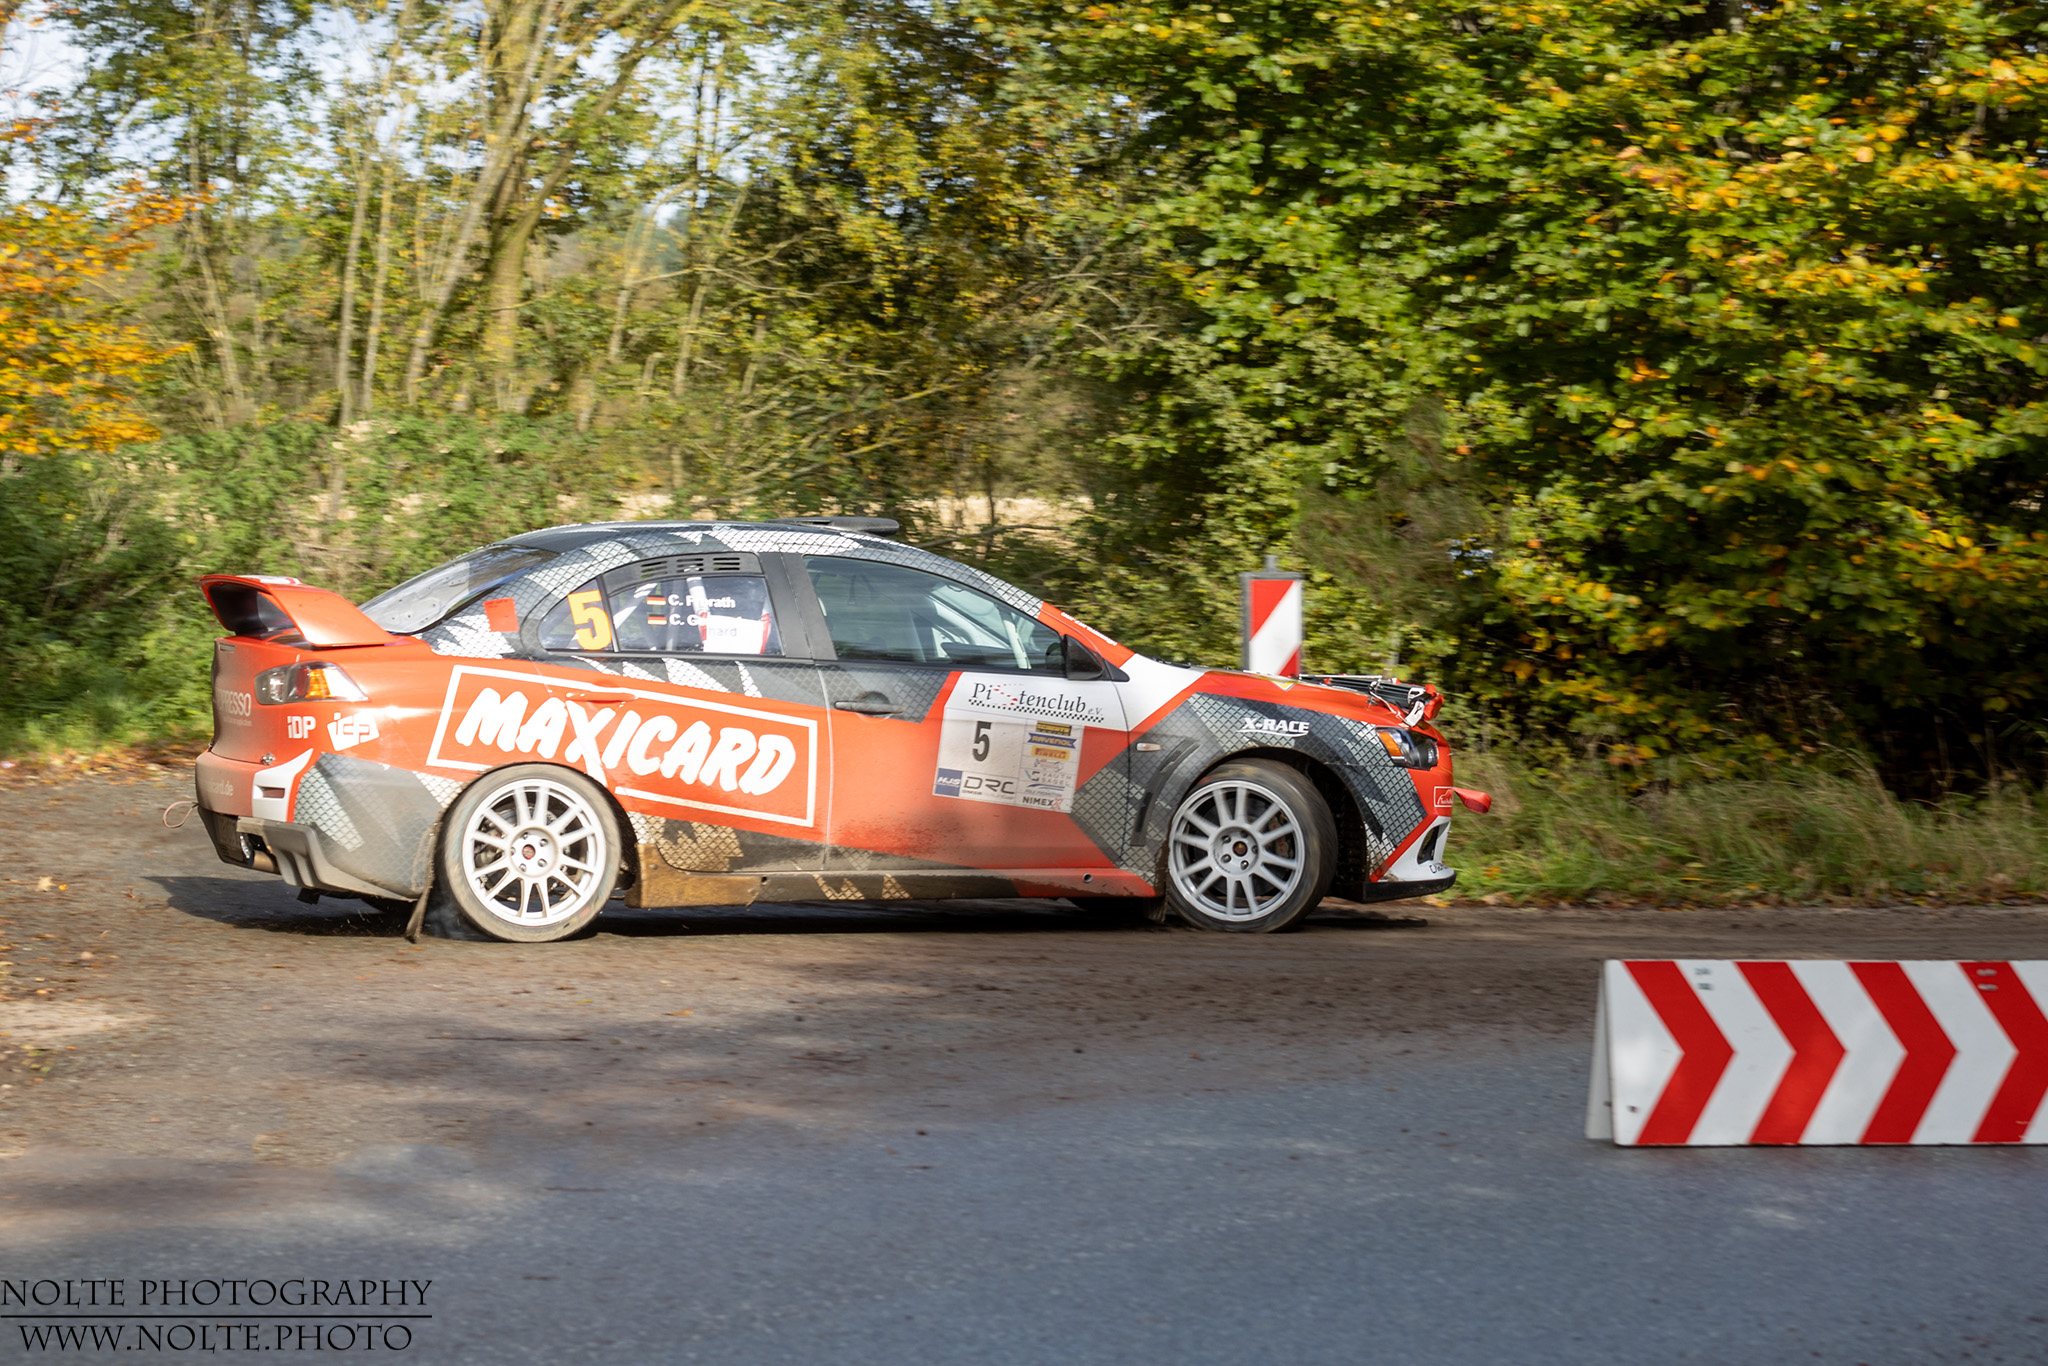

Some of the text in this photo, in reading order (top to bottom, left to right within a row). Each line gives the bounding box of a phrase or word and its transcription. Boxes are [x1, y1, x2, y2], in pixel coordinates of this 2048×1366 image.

[566, 589, 613, 651] 5
[454, 687, 797, 796] MAXICARD
[971, 720, 992, 762] 5
[1031, 735, 1073, 747] RAVENOL
[964, 776, 1015, 795] DRC
